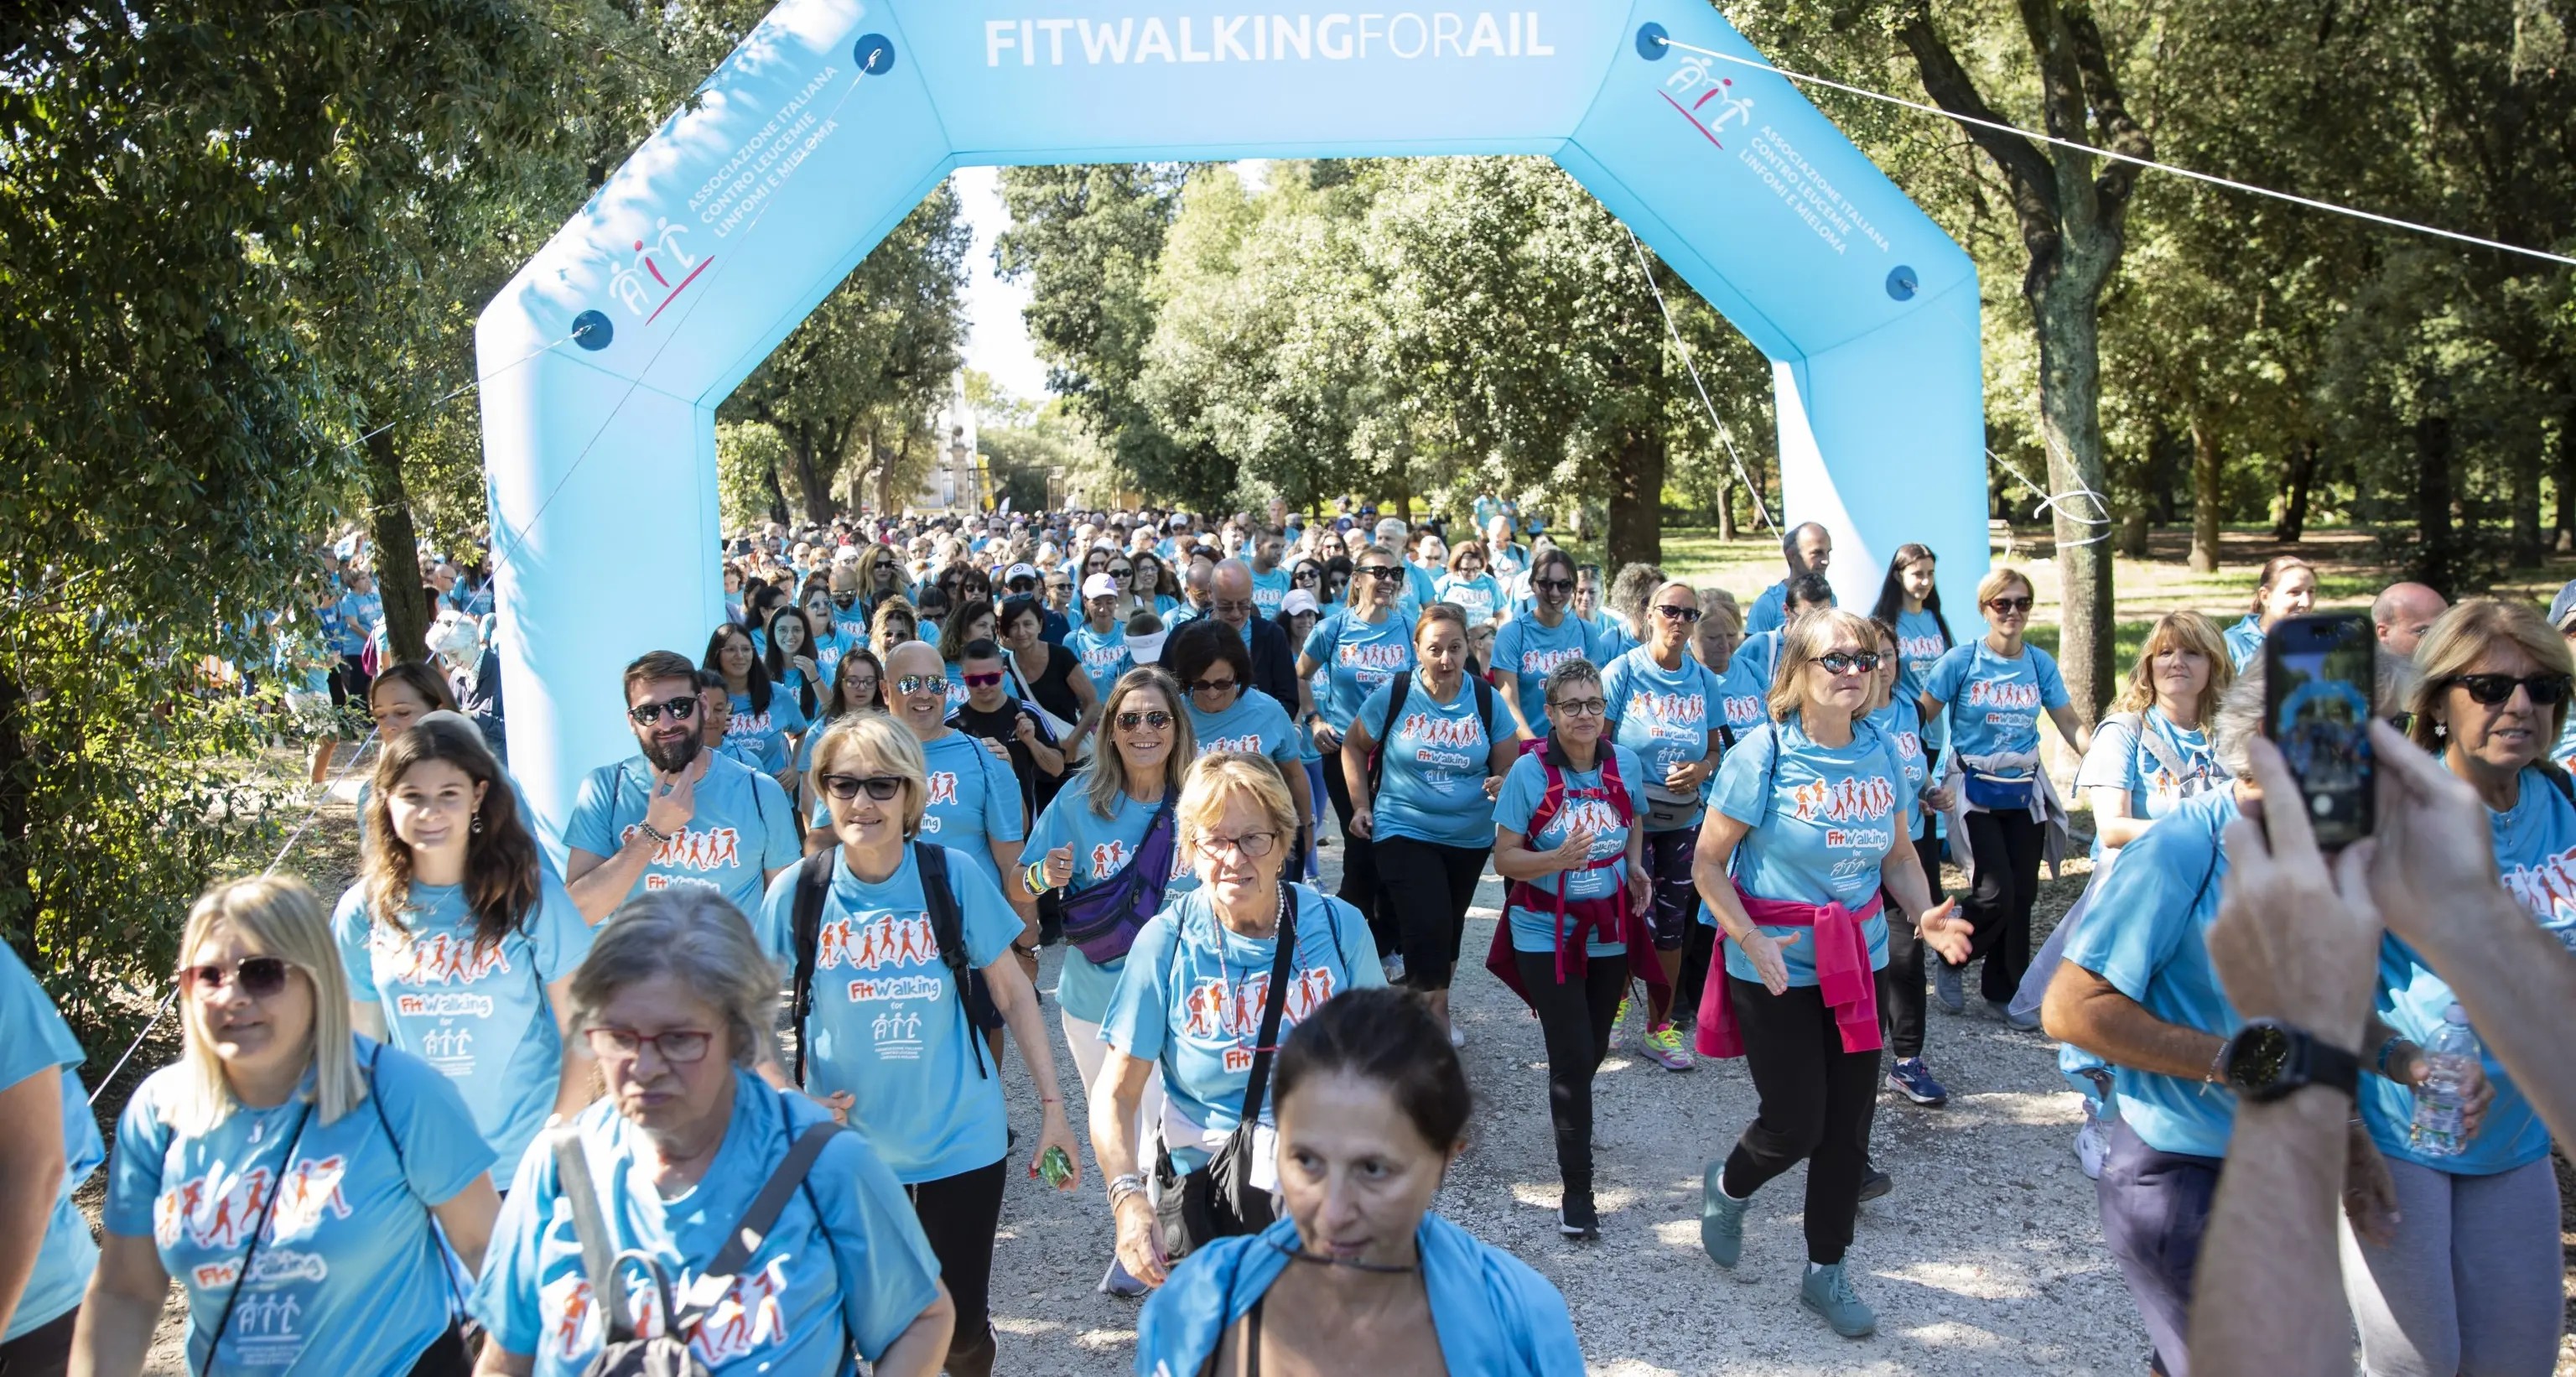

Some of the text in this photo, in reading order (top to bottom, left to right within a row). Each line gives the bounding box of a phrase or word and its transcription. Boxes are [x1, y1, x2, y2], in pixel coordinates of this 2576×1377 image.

[687, 65, 839, 212] ASSOCIAZIONE ITALIANA
[700, 111, 818, 224] CONTRO LEUCEMIE
[714, 119, 839, 238] LINFOMI E MIELOMA
[1751, 137, 1852, 236] CONTRO LEUCEMIE
[1760, 125, 1890, 252] ASSOCIAZIONE ITALIANA
[1738, 148, 1847, 255] LINFOMI E MIELOMA
